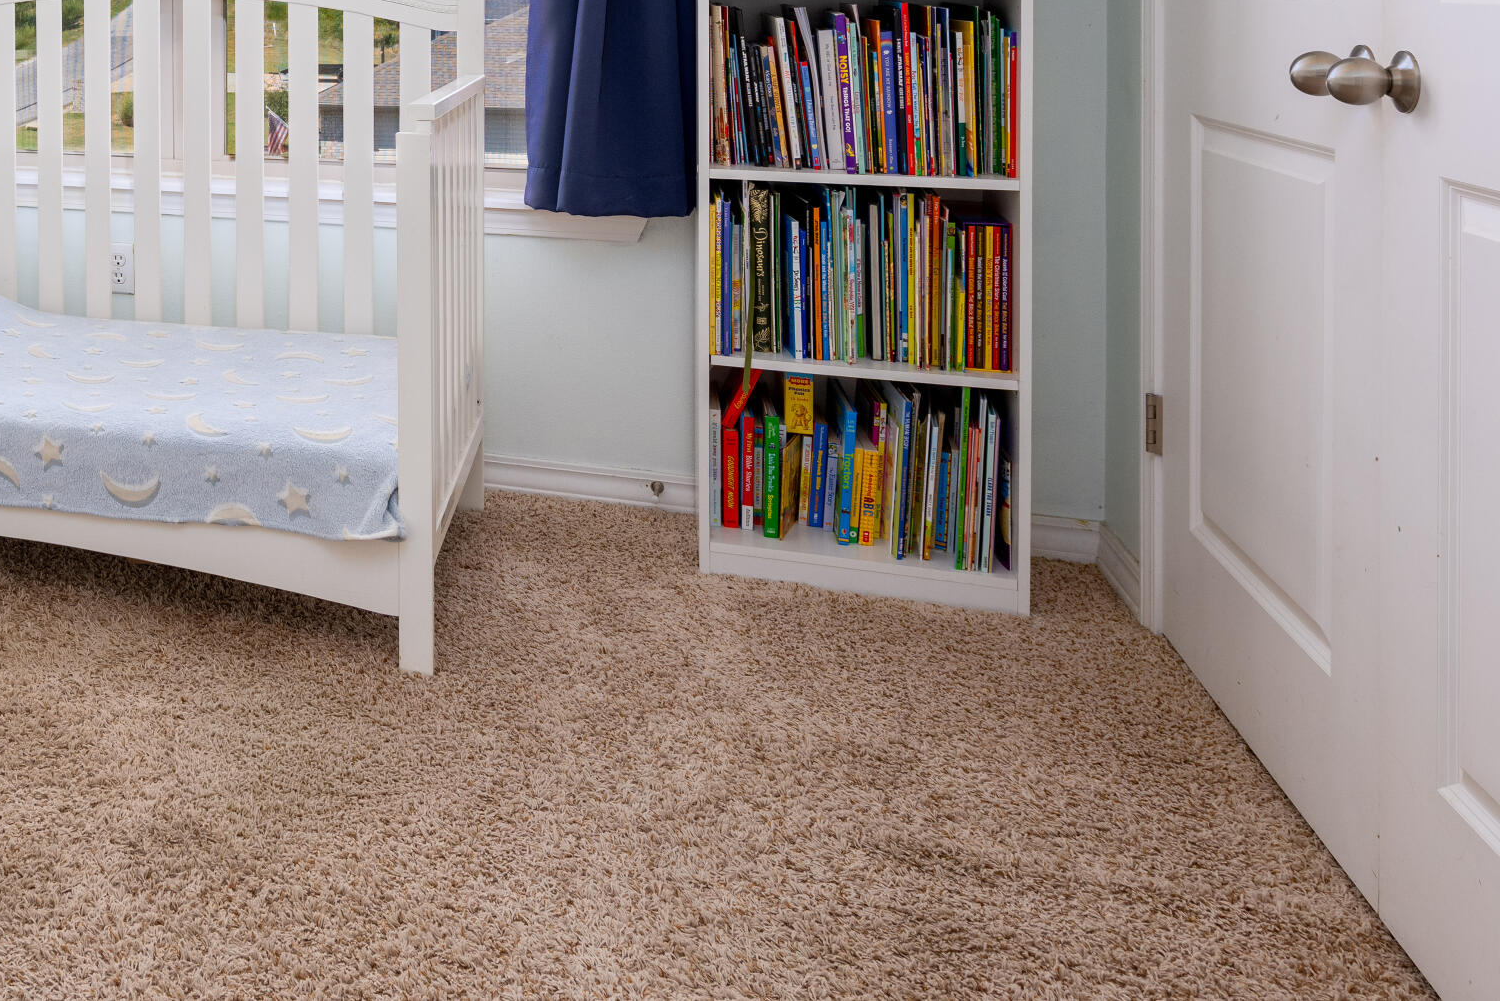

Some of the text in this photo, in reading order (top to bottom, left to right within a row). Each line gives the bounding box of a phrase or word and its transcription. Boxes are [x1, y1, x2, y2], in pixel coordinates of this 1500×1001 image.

[839, 56, 849, 84] NOISY
[754, 227, 768, 277] Dinosaurs
[843, 453, 853, 490] Tractors
[863, 497, 874, 516] ABC
